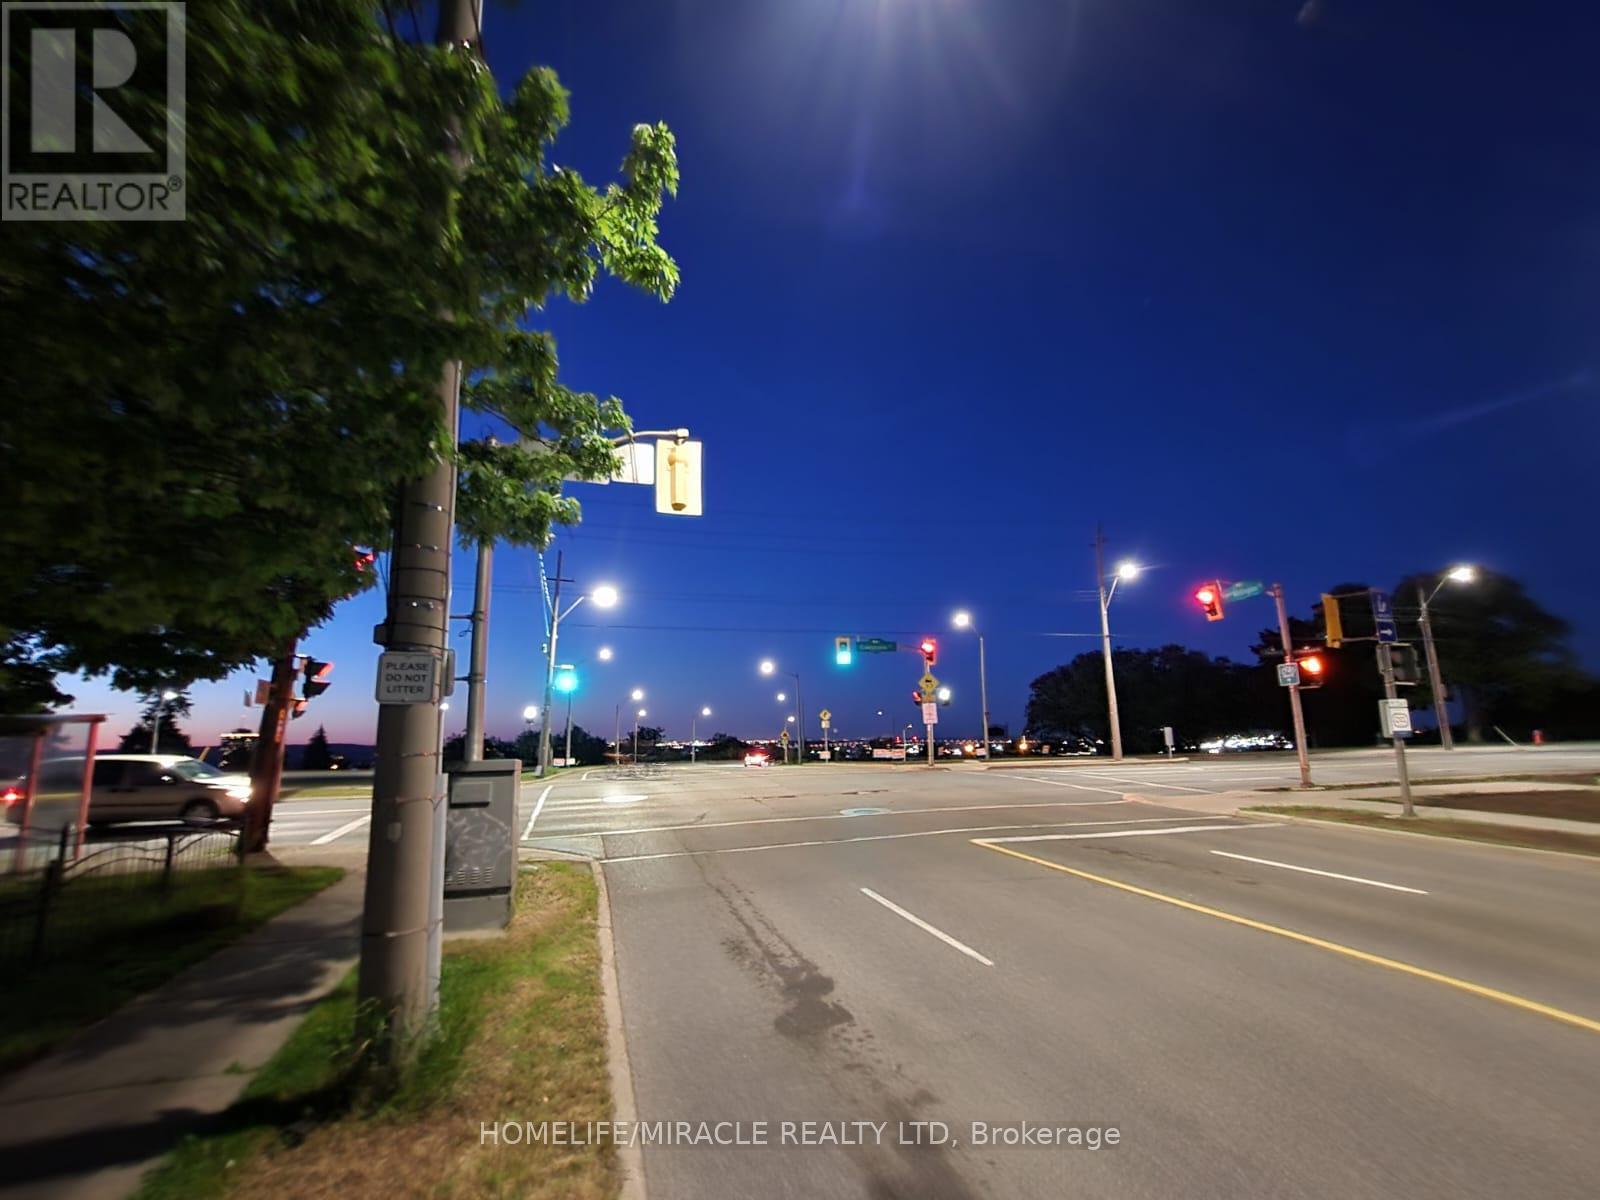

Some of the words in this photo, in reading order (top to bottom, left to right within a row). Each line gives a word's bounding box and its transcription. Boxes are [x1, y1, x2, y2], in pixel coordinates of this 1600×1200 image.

[385, 662, 430, 671] PLEASE
[385, 673, 402, 682] DO
[405, 674, 428, 682] NOT
[386, 685, 425, 694] LITTER
